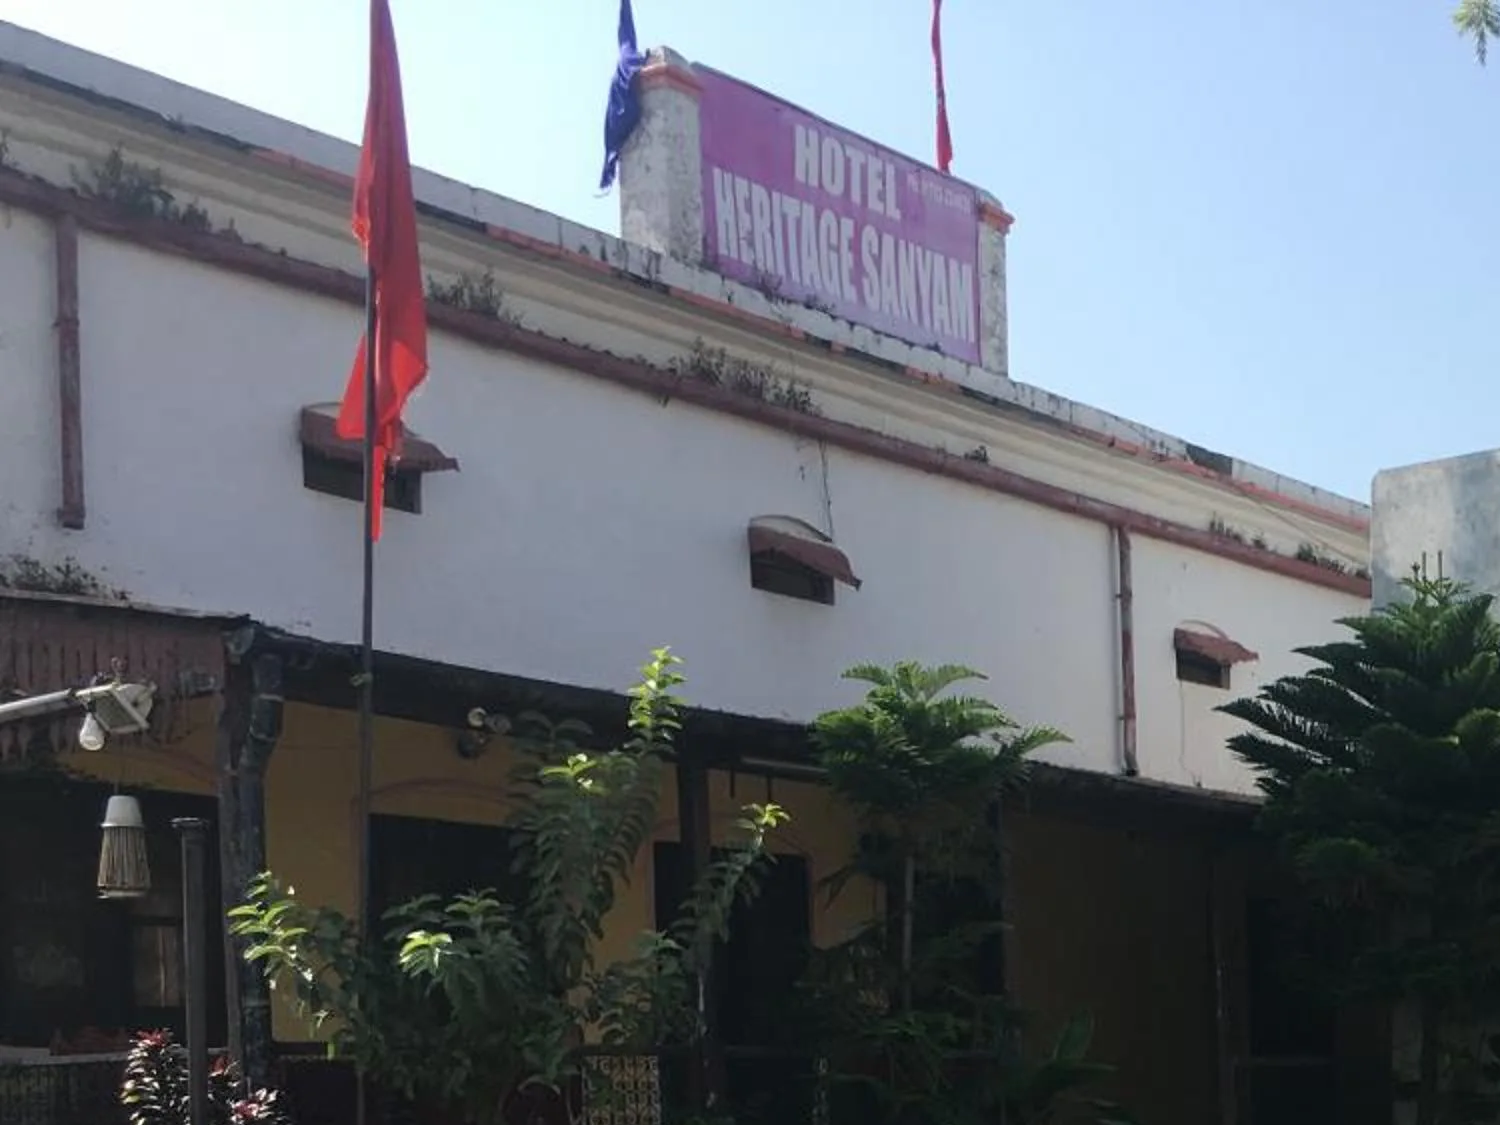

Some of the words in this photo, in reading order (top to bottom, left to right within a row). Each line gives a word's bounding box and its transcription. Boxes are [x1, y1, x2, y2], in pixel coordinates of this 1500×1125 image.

[794, 124, 901, 221] HOTEL
[713, 167, 857, 297] HERITAGE
[861, 226, 976, 344] SANYAM
